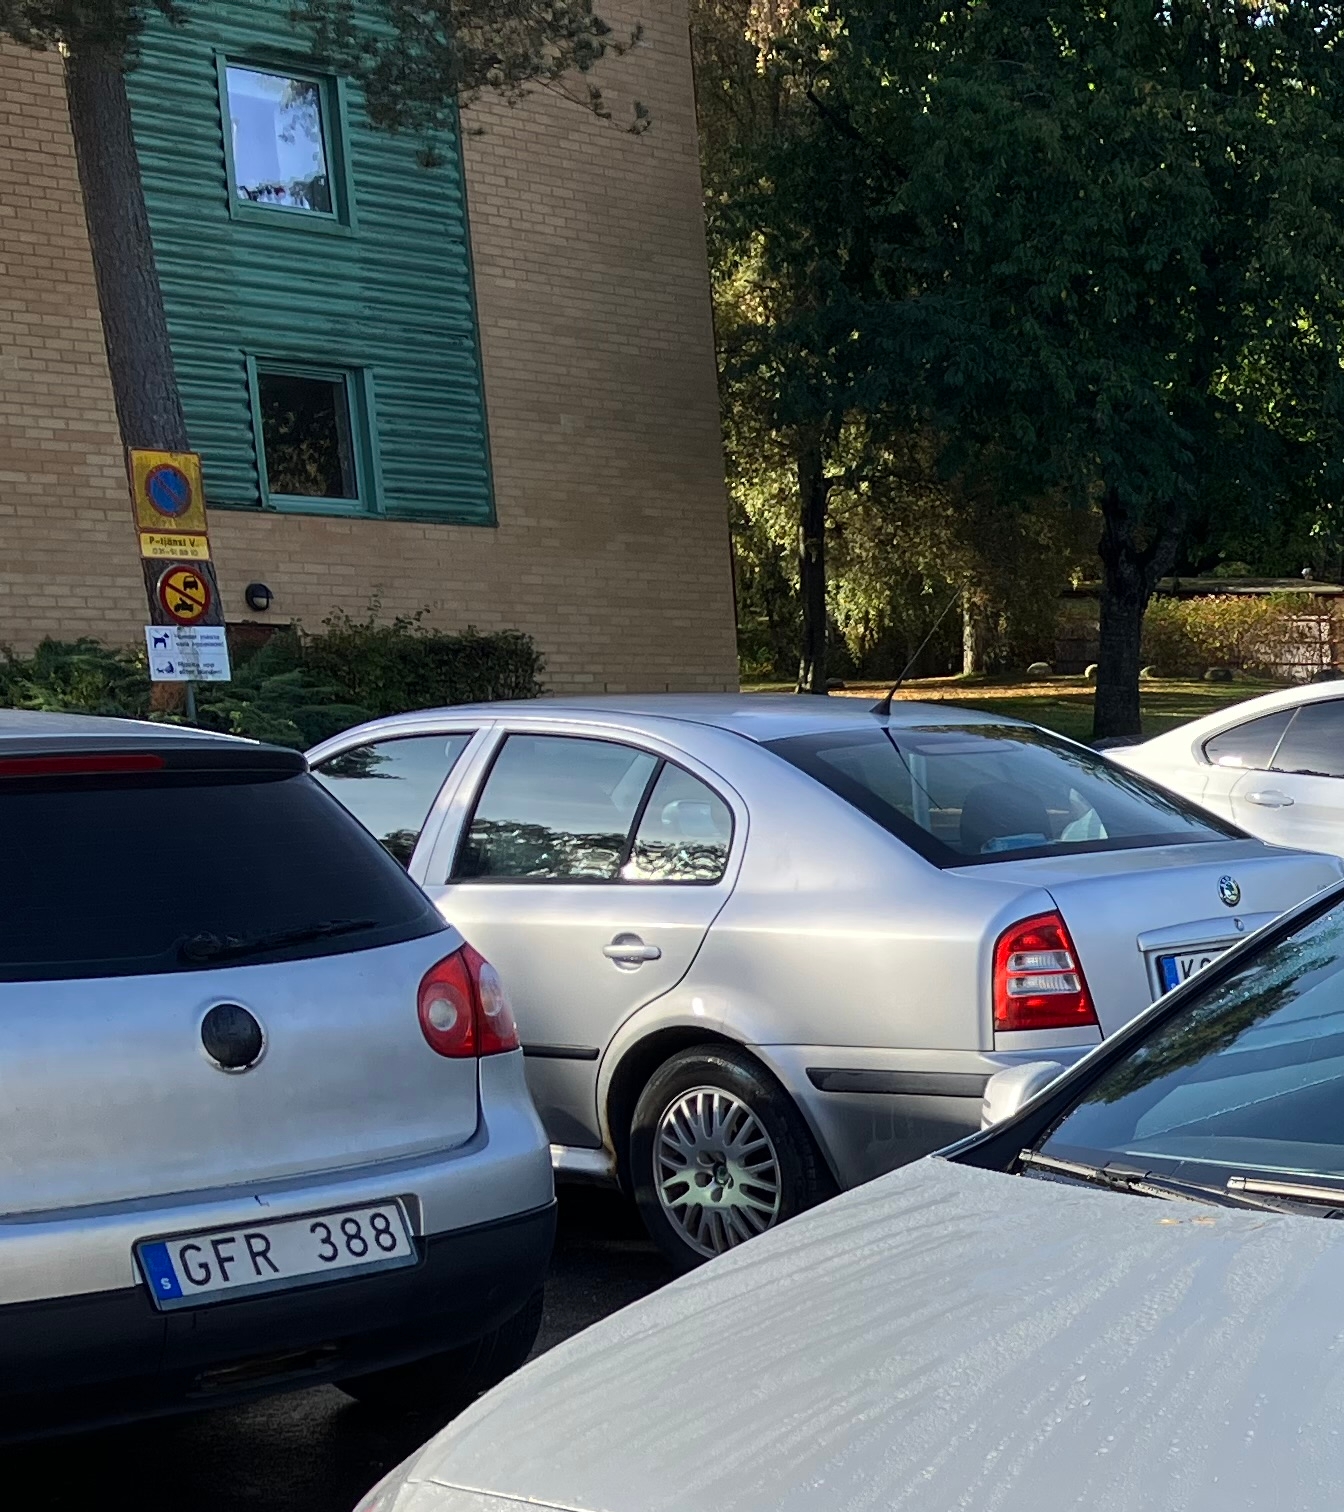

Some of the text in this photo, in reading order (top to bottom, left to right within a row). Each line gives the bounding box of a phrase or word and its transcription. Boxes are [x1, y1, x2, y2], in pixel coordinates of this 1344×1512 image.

[160, 1212, 397, 1290] S GFR 388
